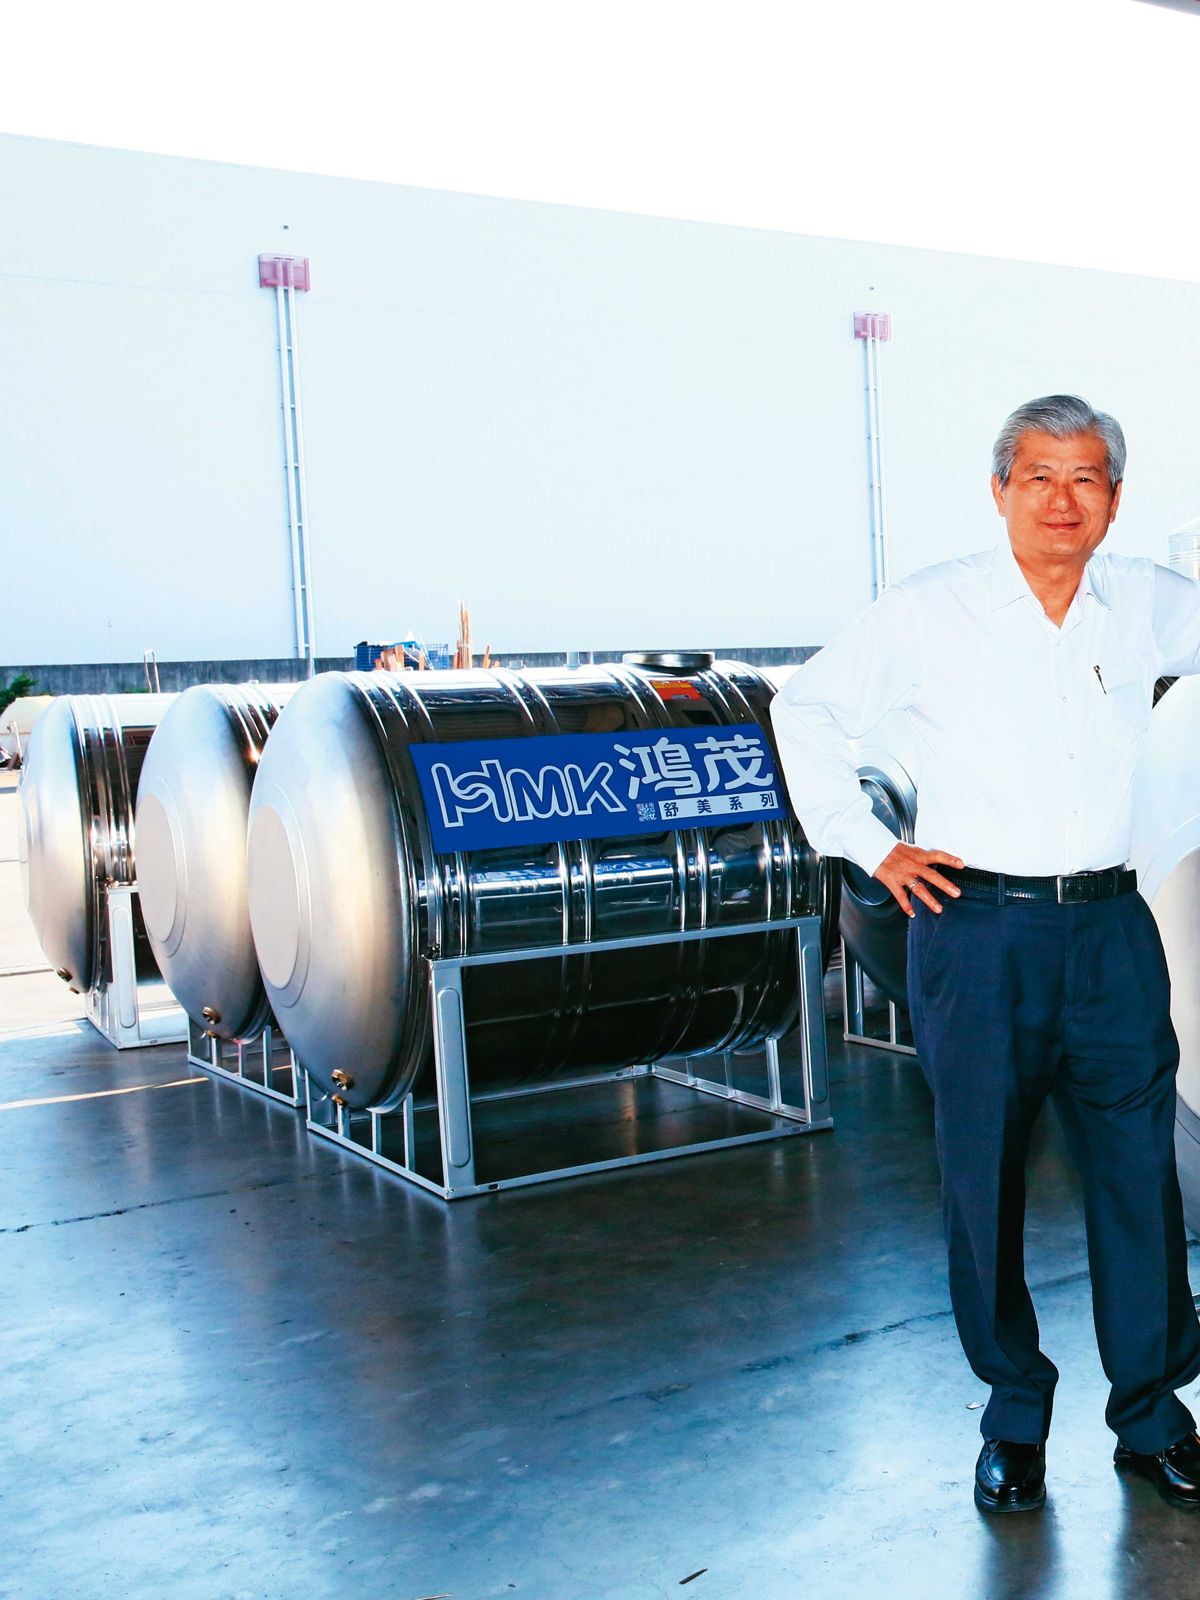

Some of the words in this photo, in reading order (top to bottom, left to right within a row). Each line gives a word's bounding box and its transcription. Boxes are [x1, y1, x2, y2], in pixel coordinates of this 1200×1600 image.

[613, 733, 774, 800] 鴻茂
[664, 792, 774, 818] 舒美系列
